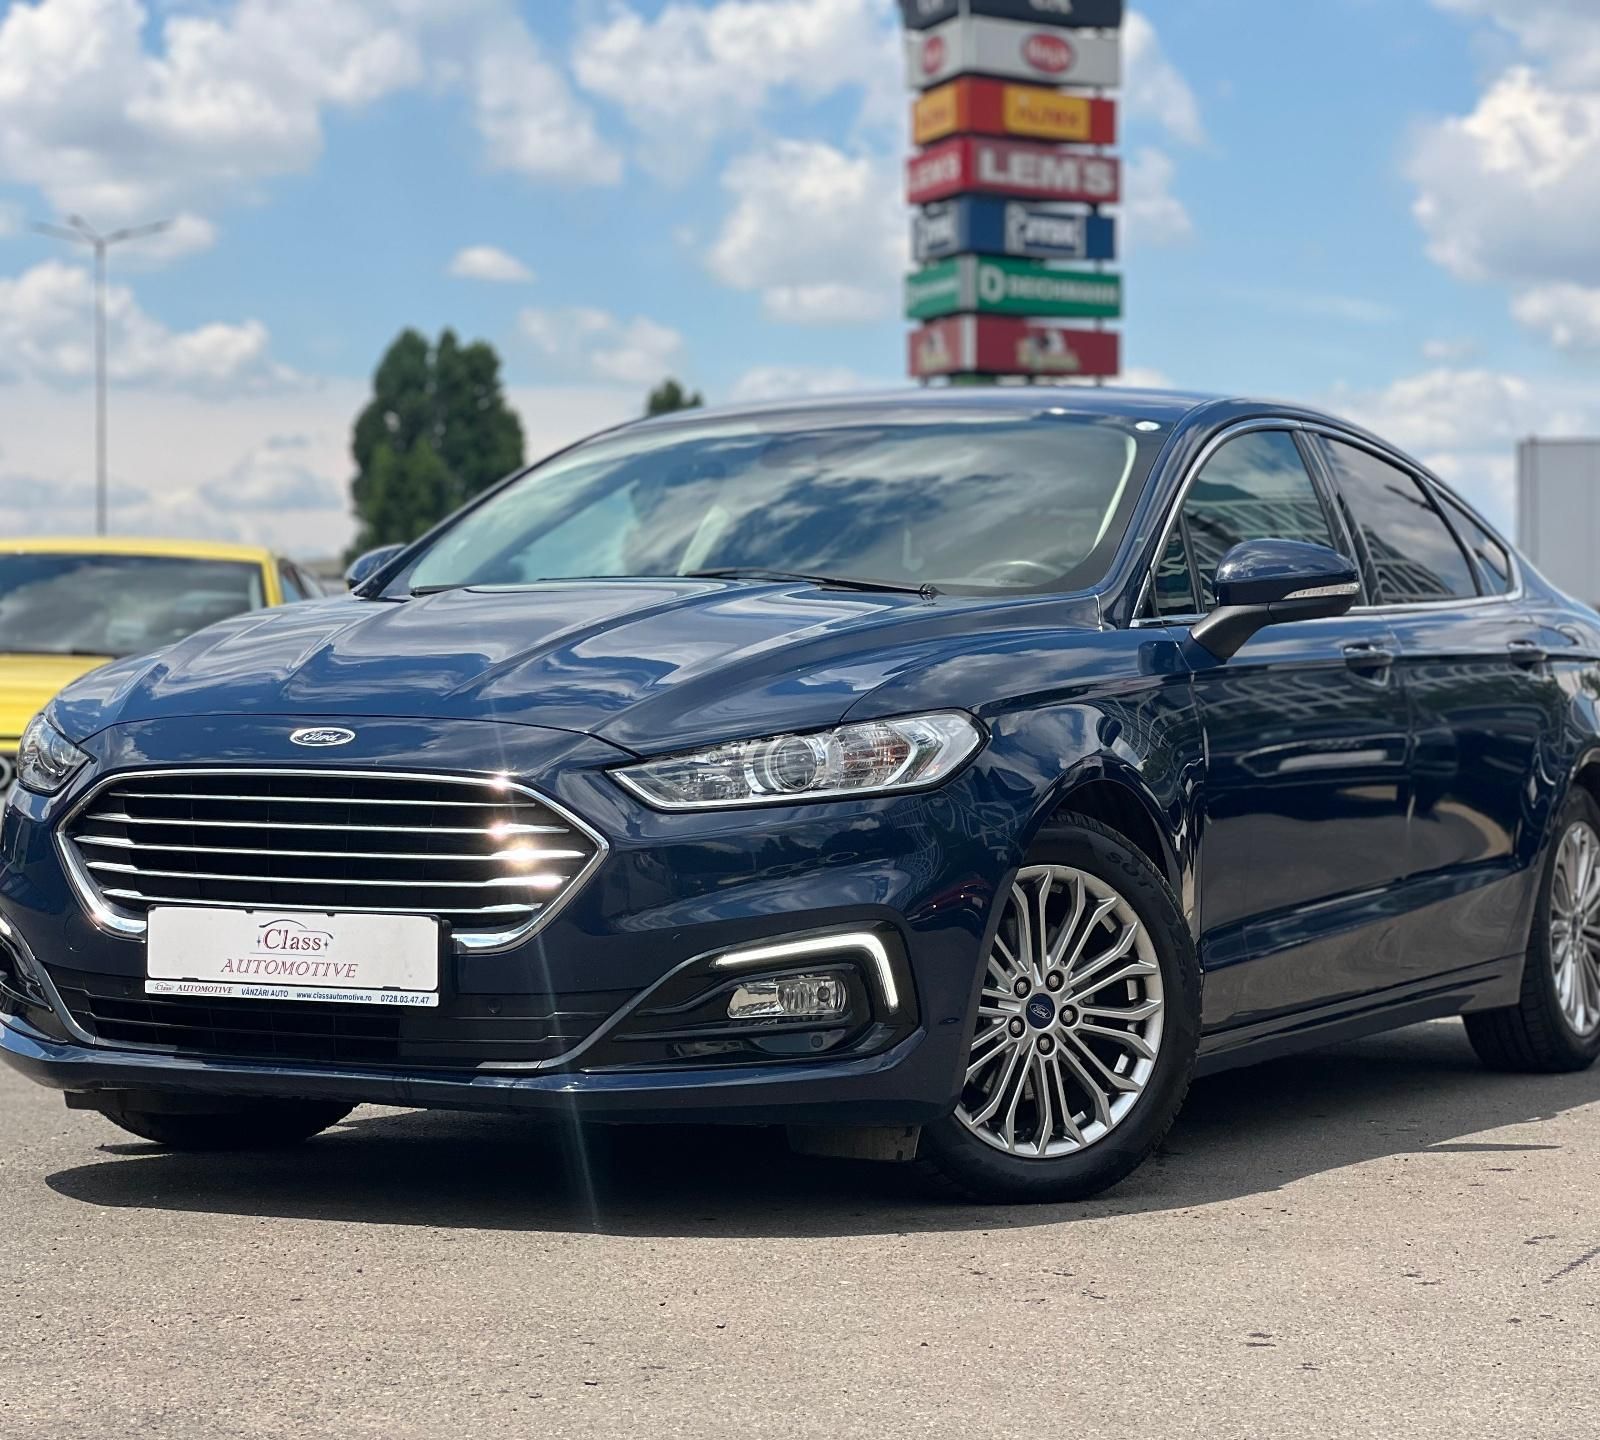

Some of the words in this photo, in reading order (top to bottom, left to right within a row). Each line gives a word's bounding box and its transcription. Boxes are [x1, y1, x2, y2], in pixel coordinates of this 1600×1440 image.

[302, 730, 342, 742] Ford
[263, 928, 322, 951] Class
[219, 958, 359, 978] AUTOMOTIVE
[177, 984, 234, 995] AUTOMOTIVE
[270, 989, 289, 998] AUTO
[296, 990, 372, 1002] www.classautomotive.ro
[380, 994, 430, 1005] 0728.03.47.47
